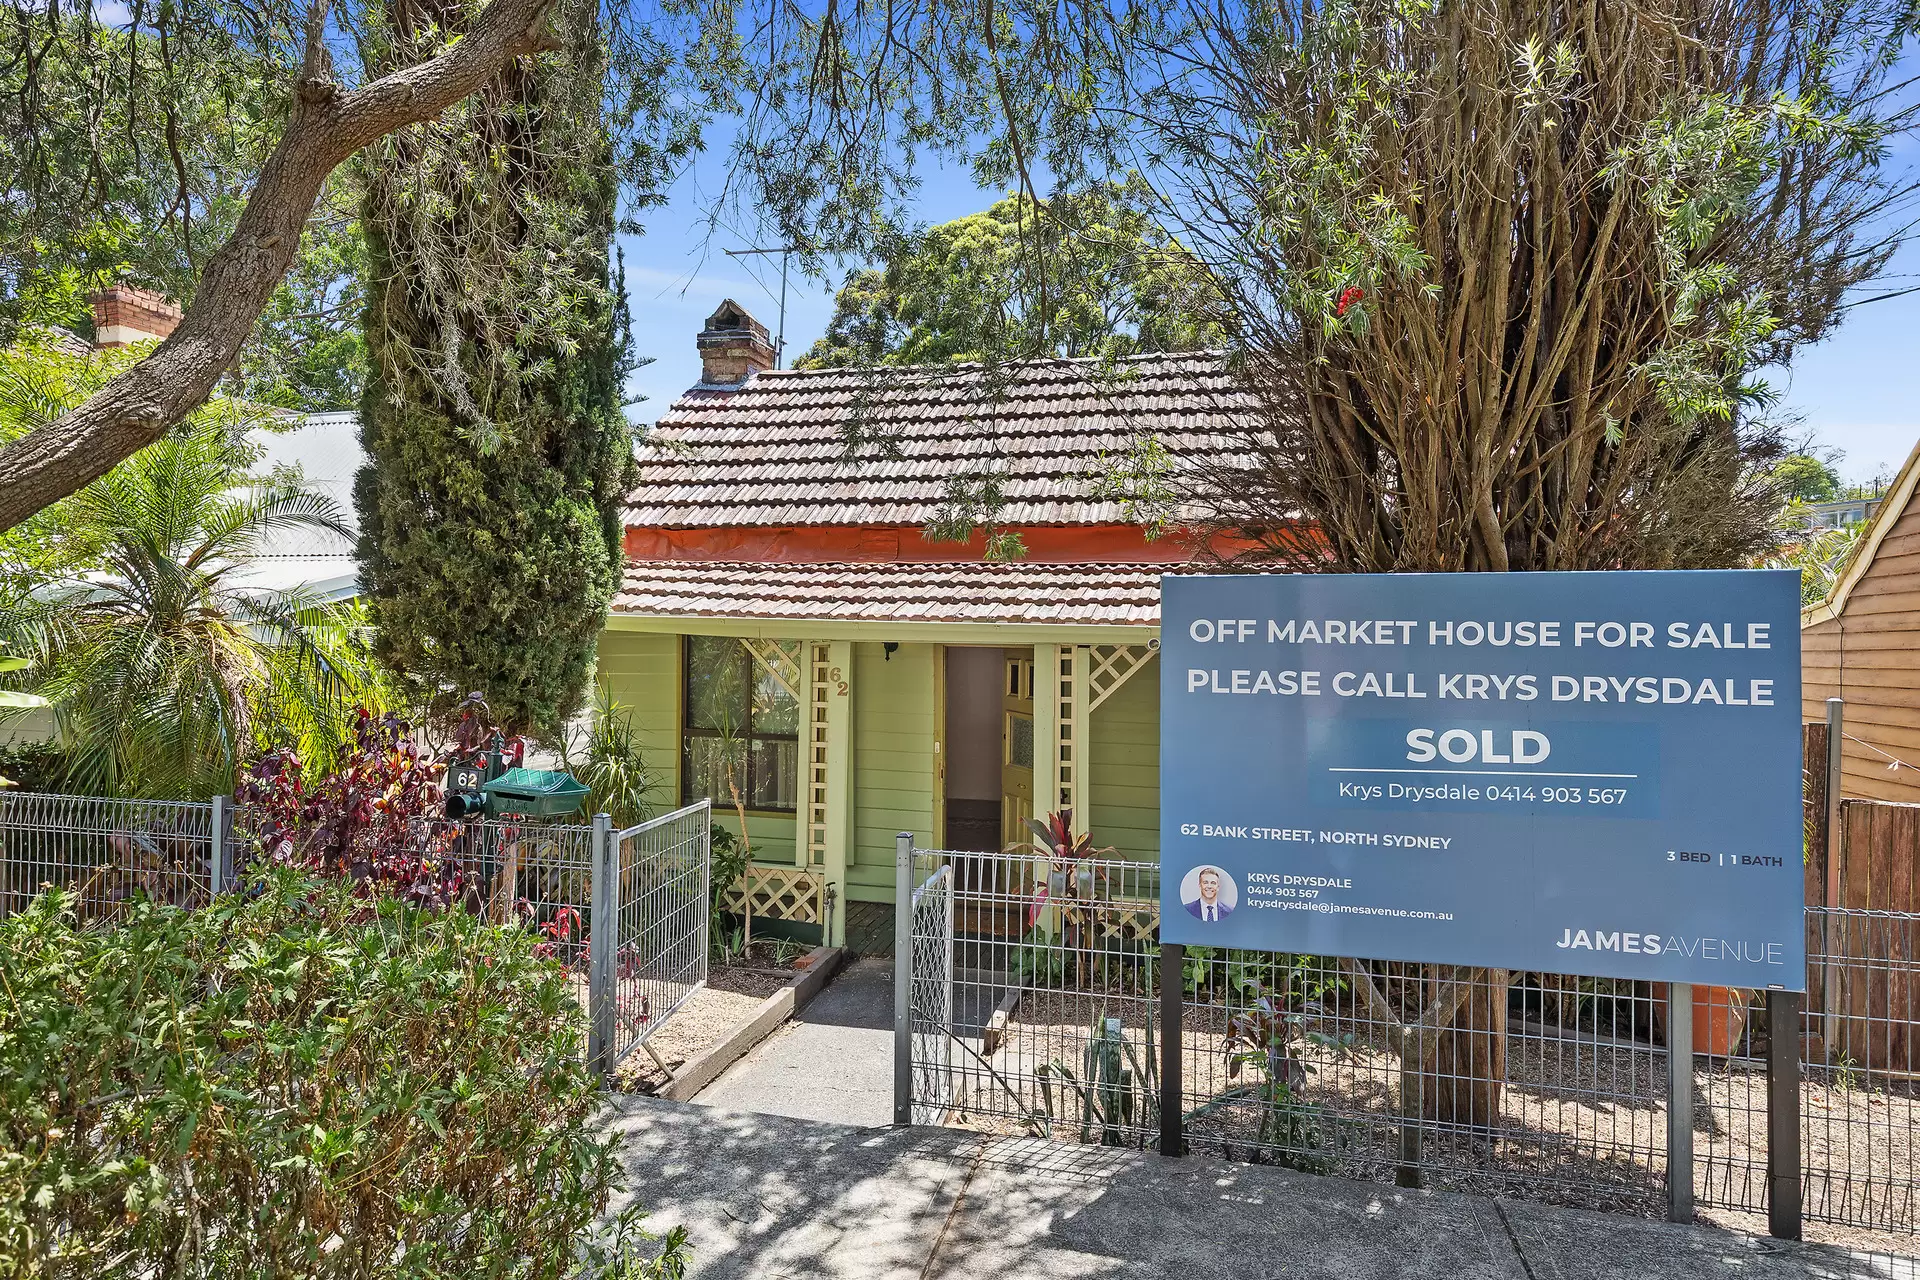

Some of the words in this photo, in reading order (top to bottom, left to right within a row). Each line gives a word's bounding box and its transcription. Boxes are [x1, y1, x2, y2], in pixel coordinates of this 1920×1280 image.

[1189, 618, 1257, 643] OFF
[1267, 619, 1418, 645] MARKET
[1428, 620, 1561, 647] HOUSE
[1574, 621, 1655, 648] FOR
[1666, 621, 1771, 649] SALE
[1187, 669, 1321, 696] PLEASE
[1332, 671, 1427, 698] CALL
[1438, 673, 1539, 701] KRYS
[1551, 675, 1775, 706] DRYSDALE
[1405, 728, 1551, 764] SOLD
[457, 772, 478, 787] 62
[1339, 782, 1383, 801] Krys
[1388, 783, 1480, 802] Drysdale
[1486, 785, 1537, 802] 0414
[1541, 786, 1582, 804] 903
[1587, 788, 1627, 805] 567
[1180, 823, 1199, 836] 62
[1202, 824, 1249, 840] BANK
[1251, 827, 1315, 845] STREET,
[1319, 830, 1378, 846] NORTH
[1382, 834, 1452, 850] SYDNEY
[1666, 850, 1676, 862] 3
[1680, 851, 1711, 863] BED
[1730, 854, 1737, 865] 1
[1741, 855, 1783, 868] BATH
[1247, 872, 1281, 885] KRYS
[1283, 874, 1352, 889] DRYSDALE
[1247, 885, 1274, 896] 0414
[1275, 887, 1297, 897] 903
[1298, 888, 1320, 899] 567
[1247, 897, 1453, 921] krysdrysdale@jamesavenue.com.au
